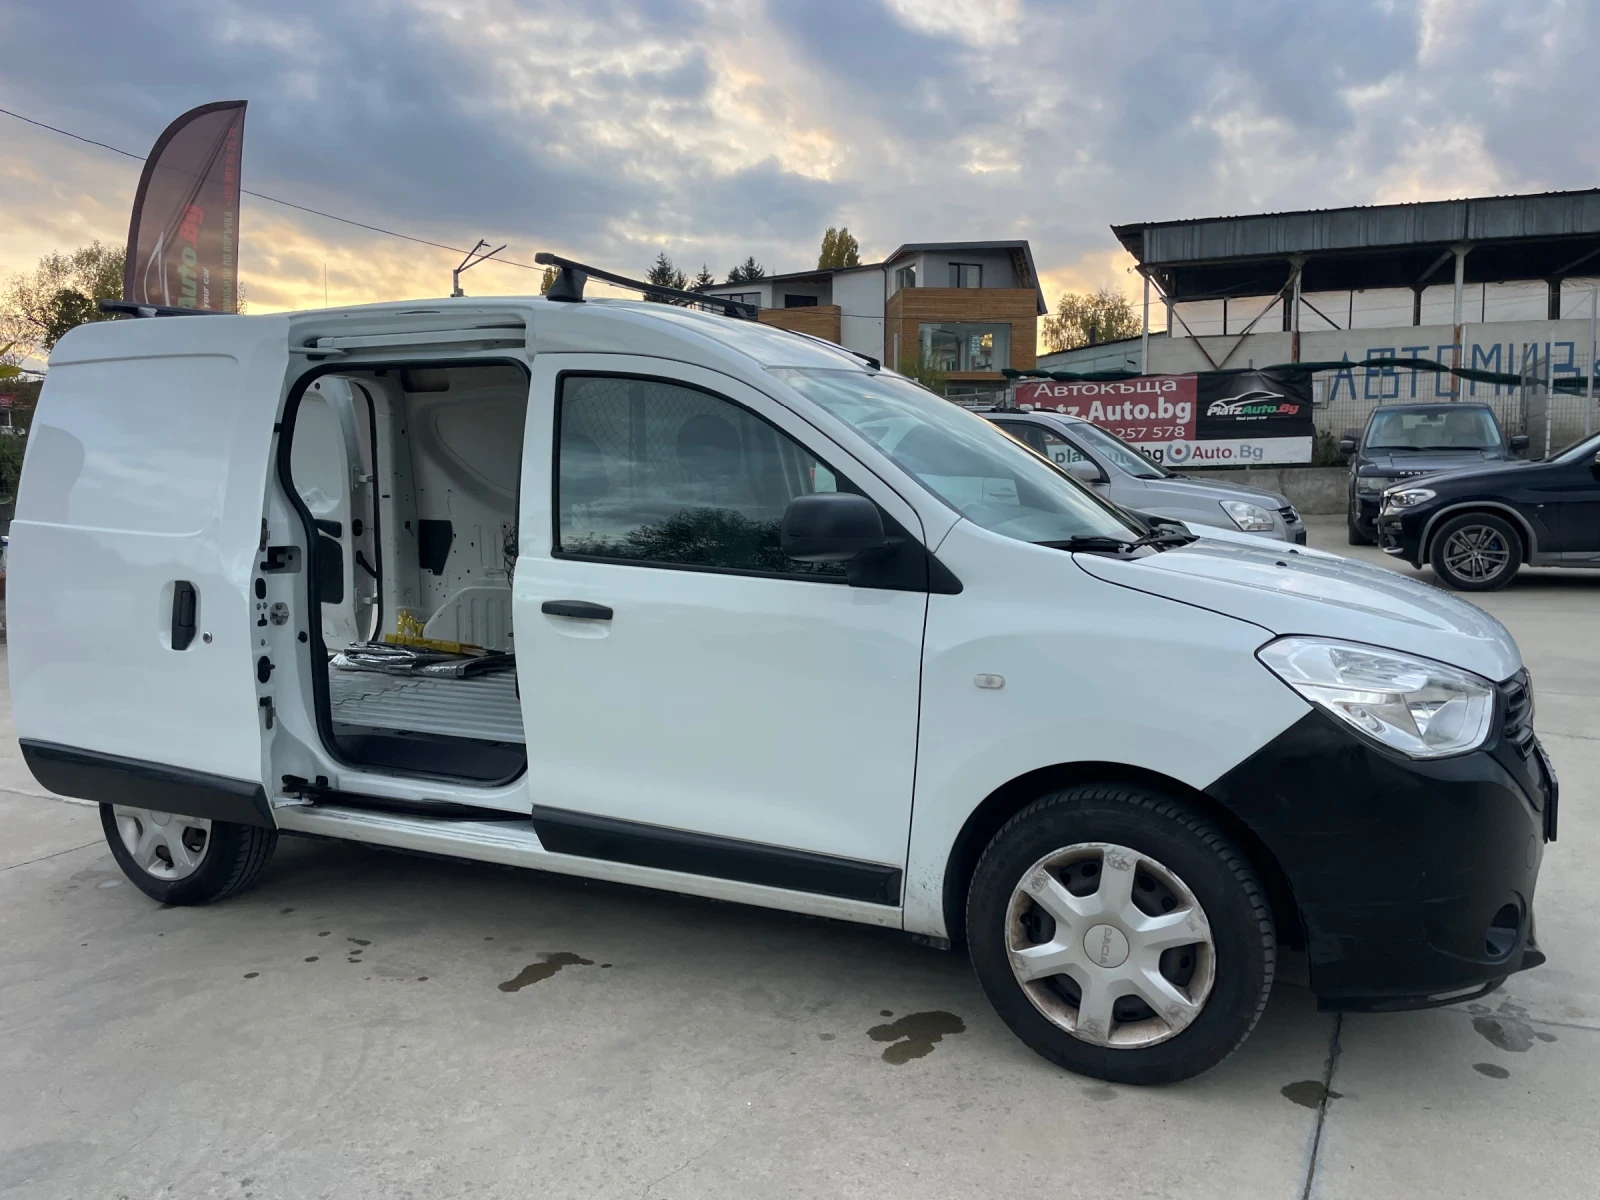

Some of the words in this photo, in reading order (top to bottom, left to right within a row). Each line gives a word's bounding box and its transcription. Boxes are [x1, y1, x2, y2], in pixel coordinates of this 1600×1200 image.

[1034, 380, 1177, 397] Автокъща
[1115, 427, 1147, 440] 257
[1152, 426, 1186, 438] 578
[1100, 927, 1113, 964] DACIA
